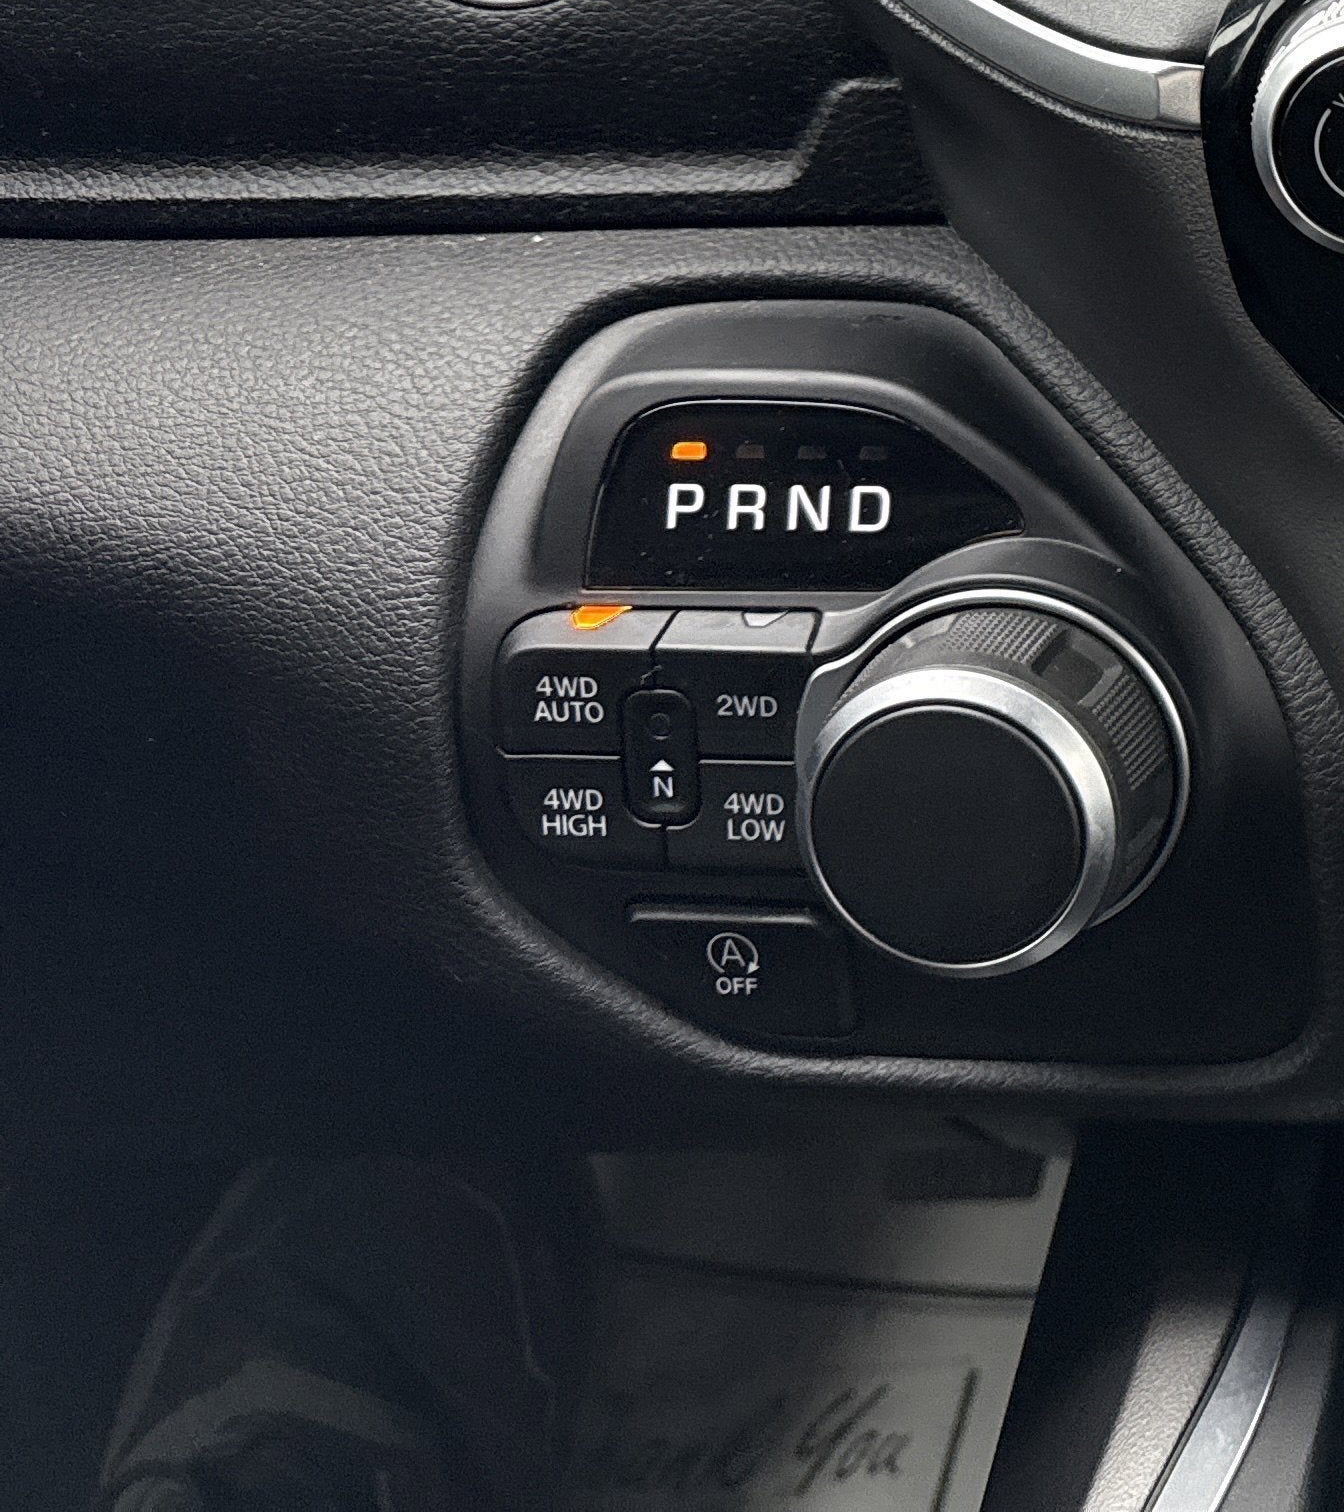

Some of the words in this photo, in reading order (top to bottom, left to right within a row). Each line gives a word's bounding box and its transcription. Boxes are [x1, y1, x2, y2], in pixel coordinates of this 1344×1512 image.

[666, 483, 705, 529] P
[726, 484, 767, 530] R
[785, 485, 830, 531] N
[848, 485, 891, 532] D
[537, 676, 598, 698] 4WD
[534, 701, 604, 723] AUTO
[717, 695, 778, 718] 2WD
[653, 777, 673, 797] N
[543, 788, 603, 812] 4WD
[723, 793, 784, 815] 4WD
[542, 813, 607, 837] HIGH
[727, 818, 785, 841] LOW
[715, 977, 758, 994] OFF
